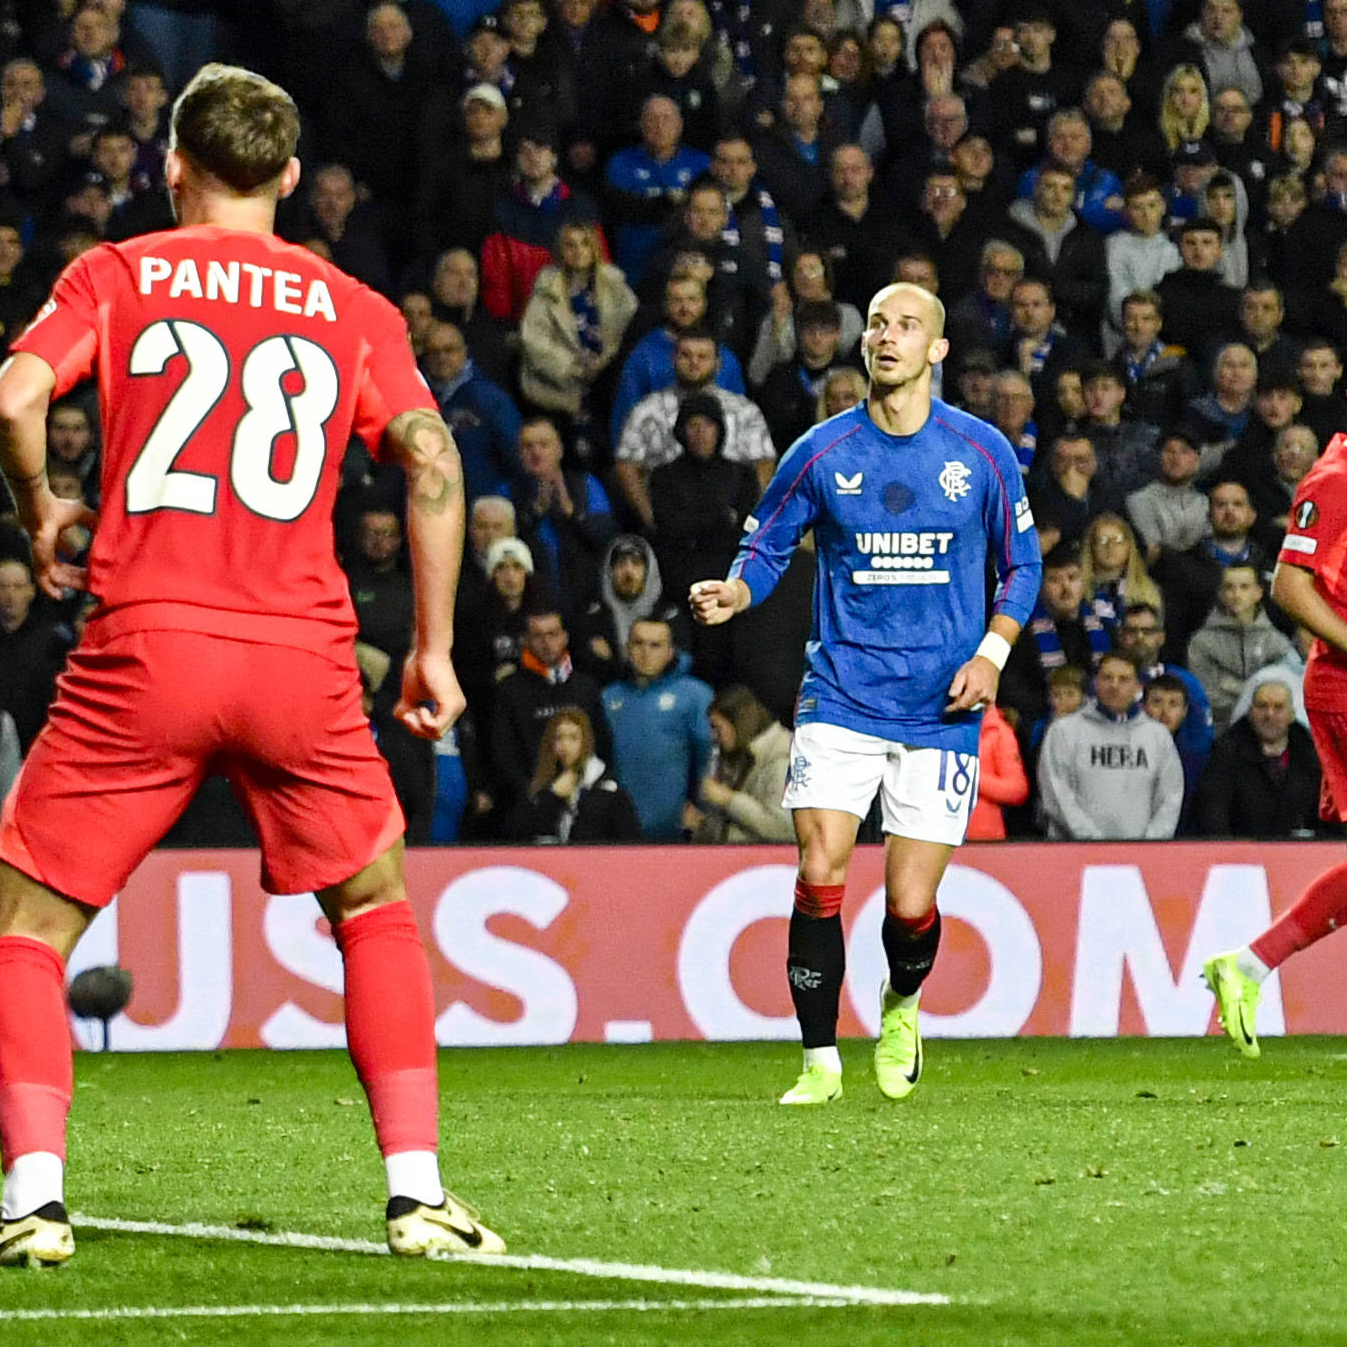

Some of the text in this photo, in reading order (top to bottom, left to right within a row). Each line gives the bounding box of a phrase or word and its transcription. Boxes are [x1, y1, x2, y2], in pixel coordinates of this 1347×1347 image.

[139, 255, 338, 322] PANTEA
[125, 319, 341, 523] 28
[855, 532, 954, 555] UNIBET
[936, 749, 971, 796] 18
